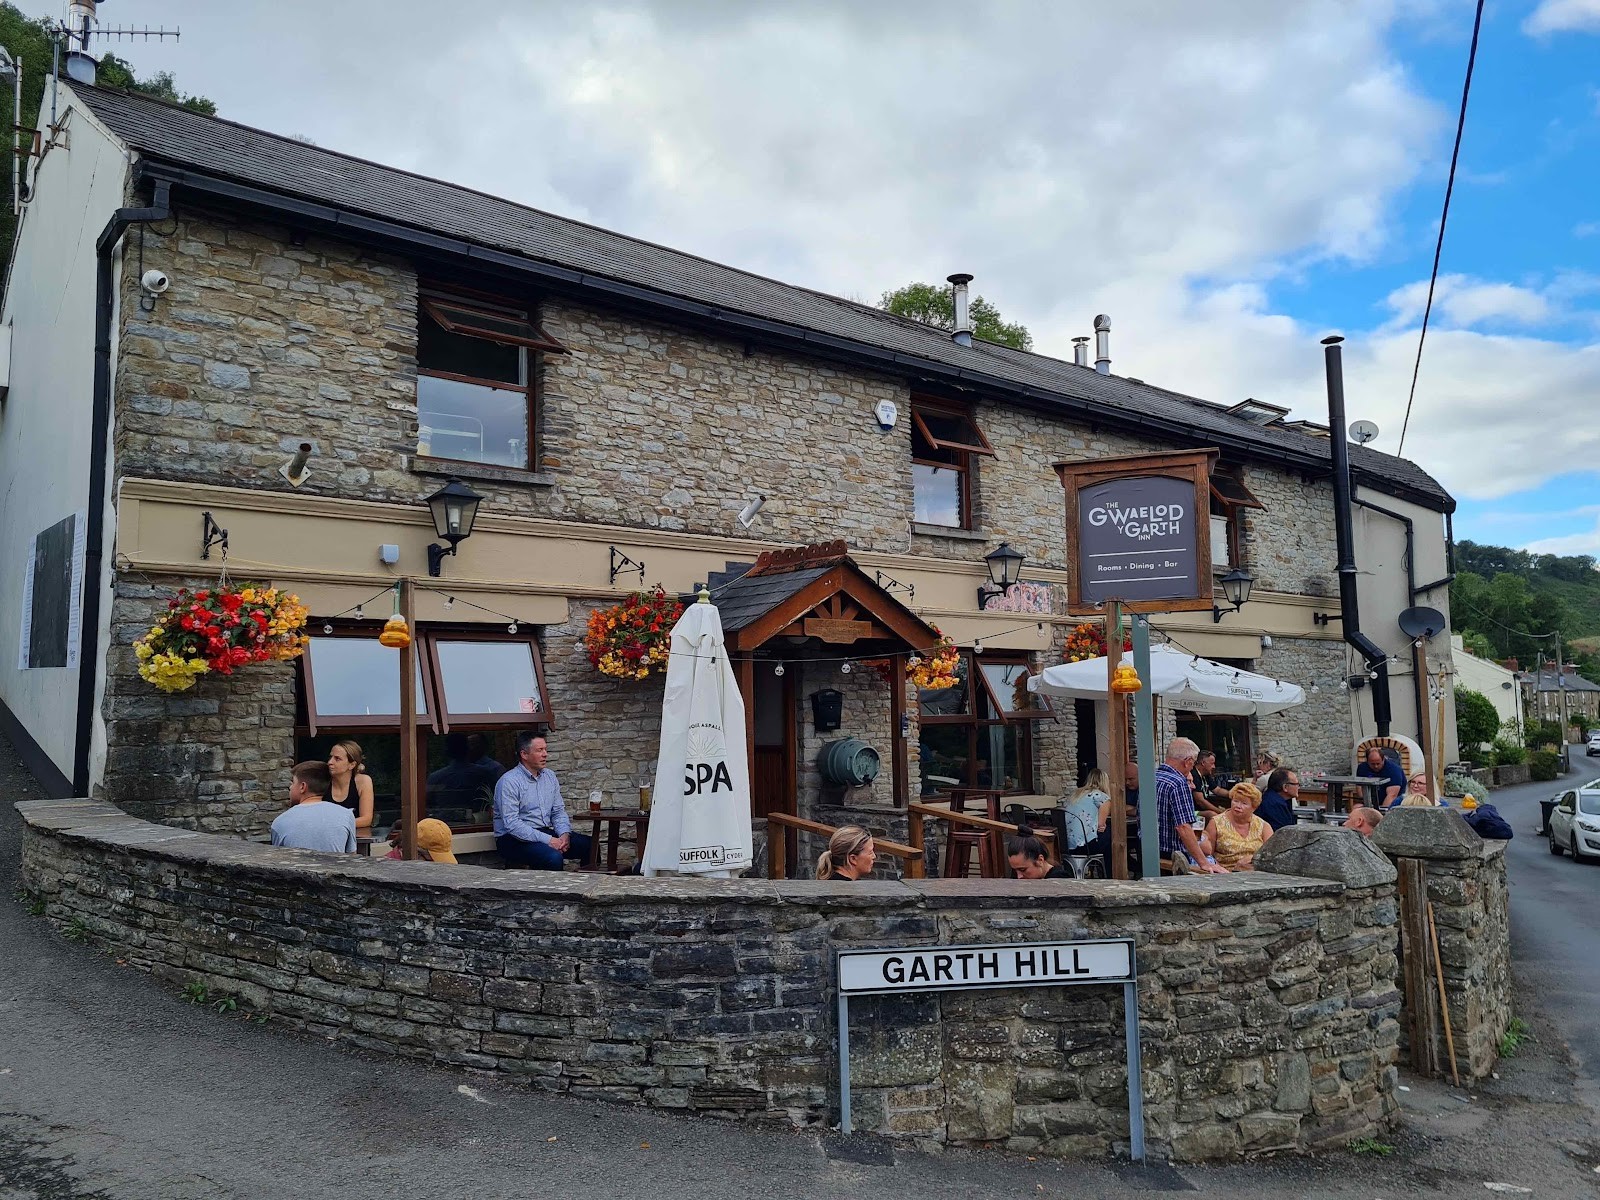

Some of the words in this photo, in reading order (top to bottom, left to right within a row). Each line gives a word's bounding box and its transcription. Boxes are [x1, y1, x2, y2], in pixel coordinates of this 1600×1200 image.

[1088, 504, 1184, 526] GWAELOD
[1117, 525, 1124, 535] Y
[1124, 521, 1180, 538] GARTH
[1129, 562, 1155, 570] Dining
[1164, 560, 1178, 568] Bar
[679, 849, 719, 861] SUFFOLK
[882, 952, 999, 983] GARTH
[1015, 948, 1090, 977] HILL
